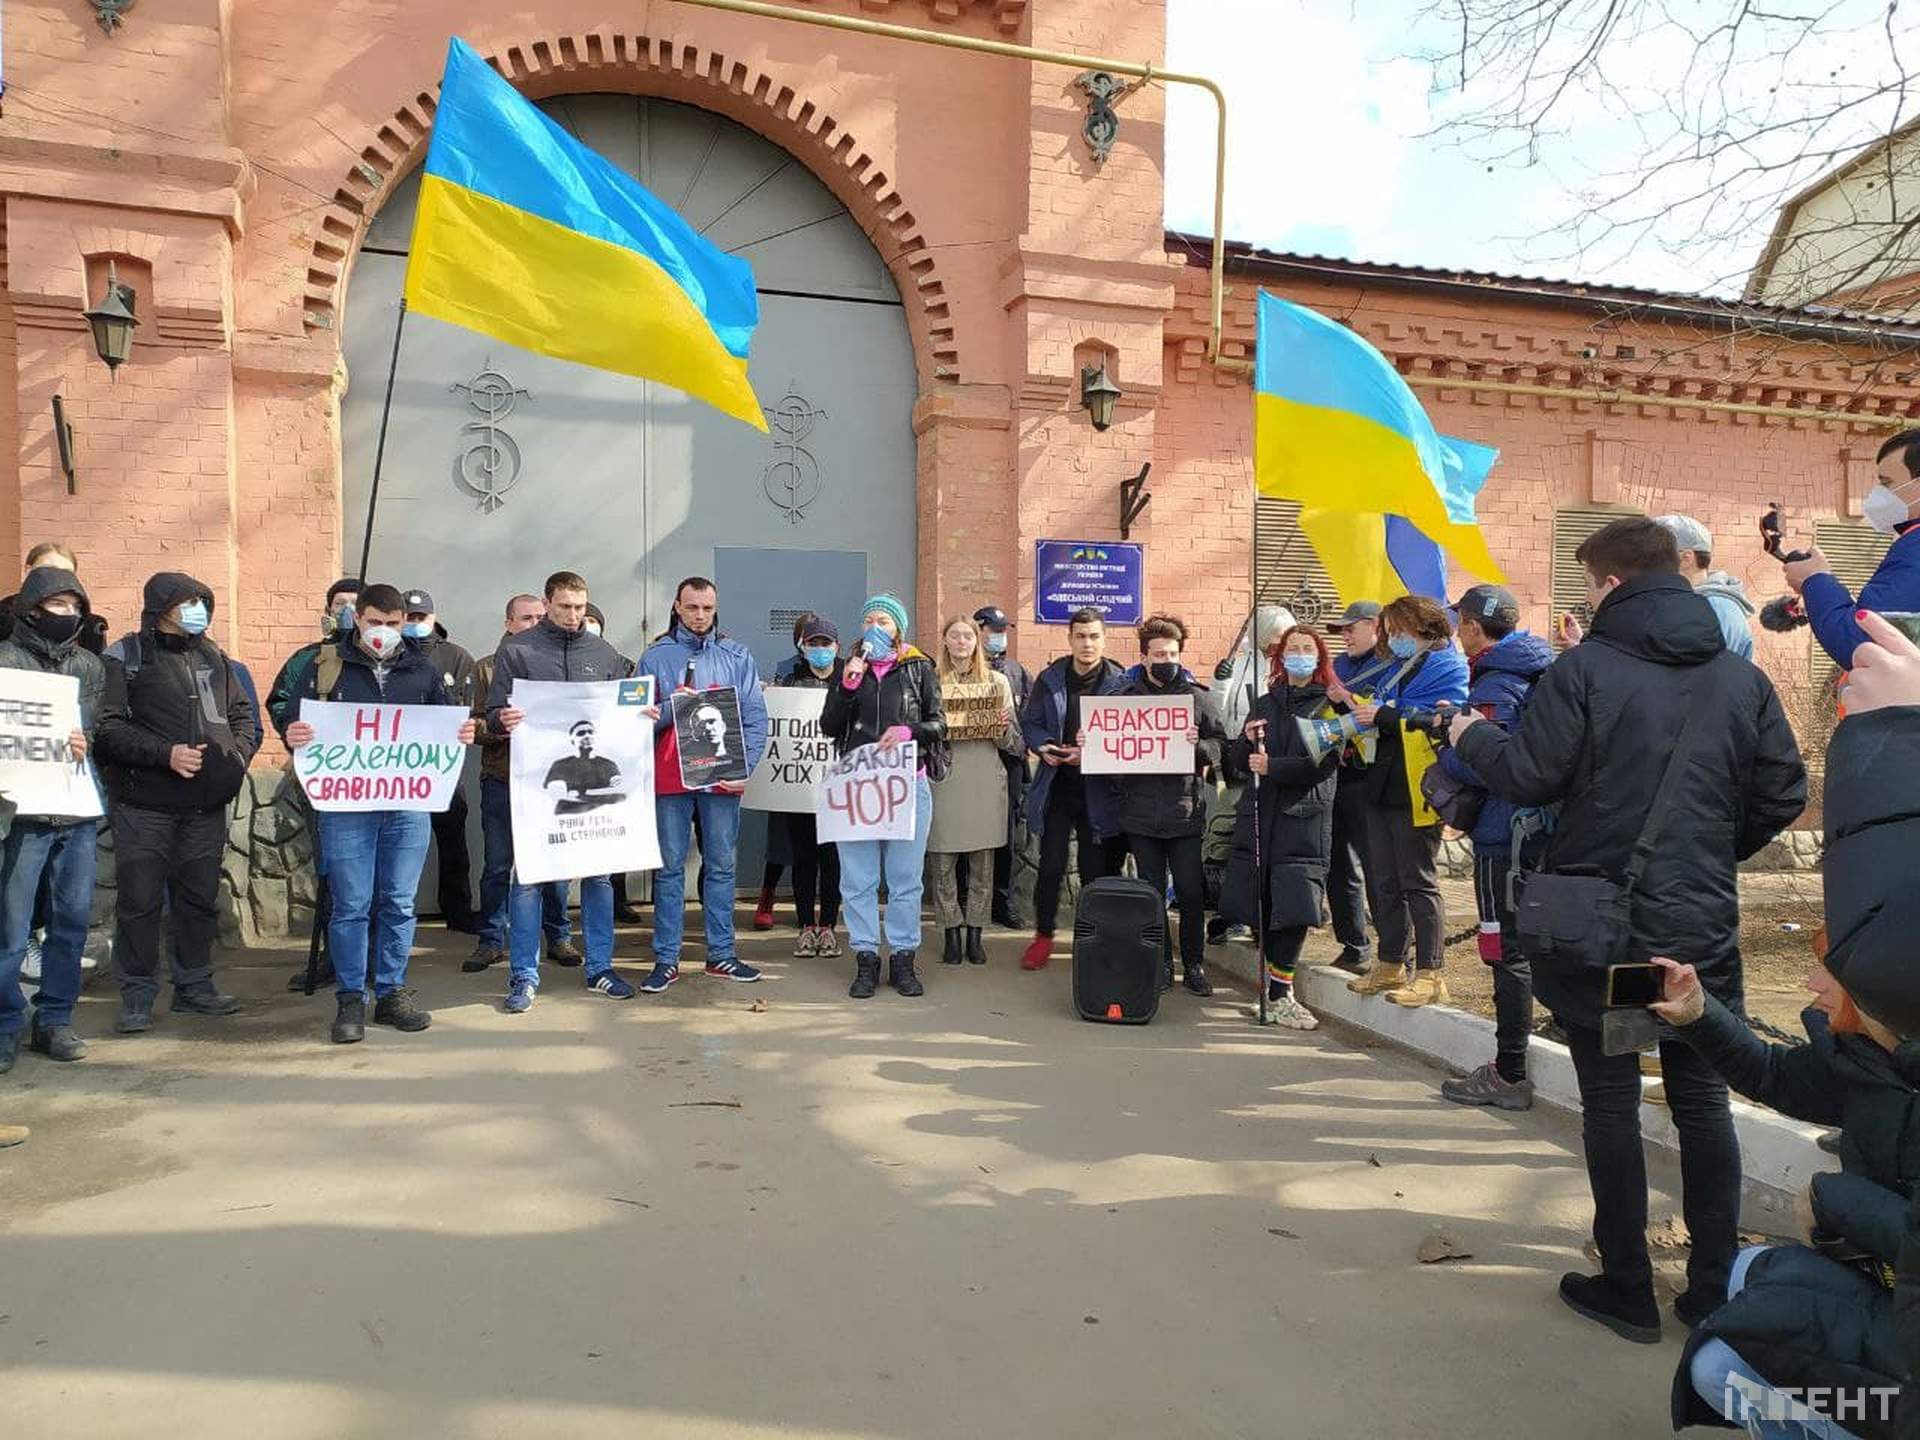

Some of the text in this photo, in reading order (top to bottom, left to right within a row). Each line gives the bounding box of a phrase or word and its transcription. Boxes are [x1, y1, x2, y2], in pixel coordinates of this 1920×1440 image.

[947, 699, 966, 711] ВИ
[355, 708, 402, 742] НІ
[767, 718, 829, 739] ОГОДН
[1088, 707, 1189, 732] АВАКОВ
[767, 740, 838, 762] А ЗАВТ
[1103, 733, 1171, 761] ЧОРТ
[770, 762, 813, 784] УСІХ
[305, 776, 432, 800] СВАВІЛЛЮ
